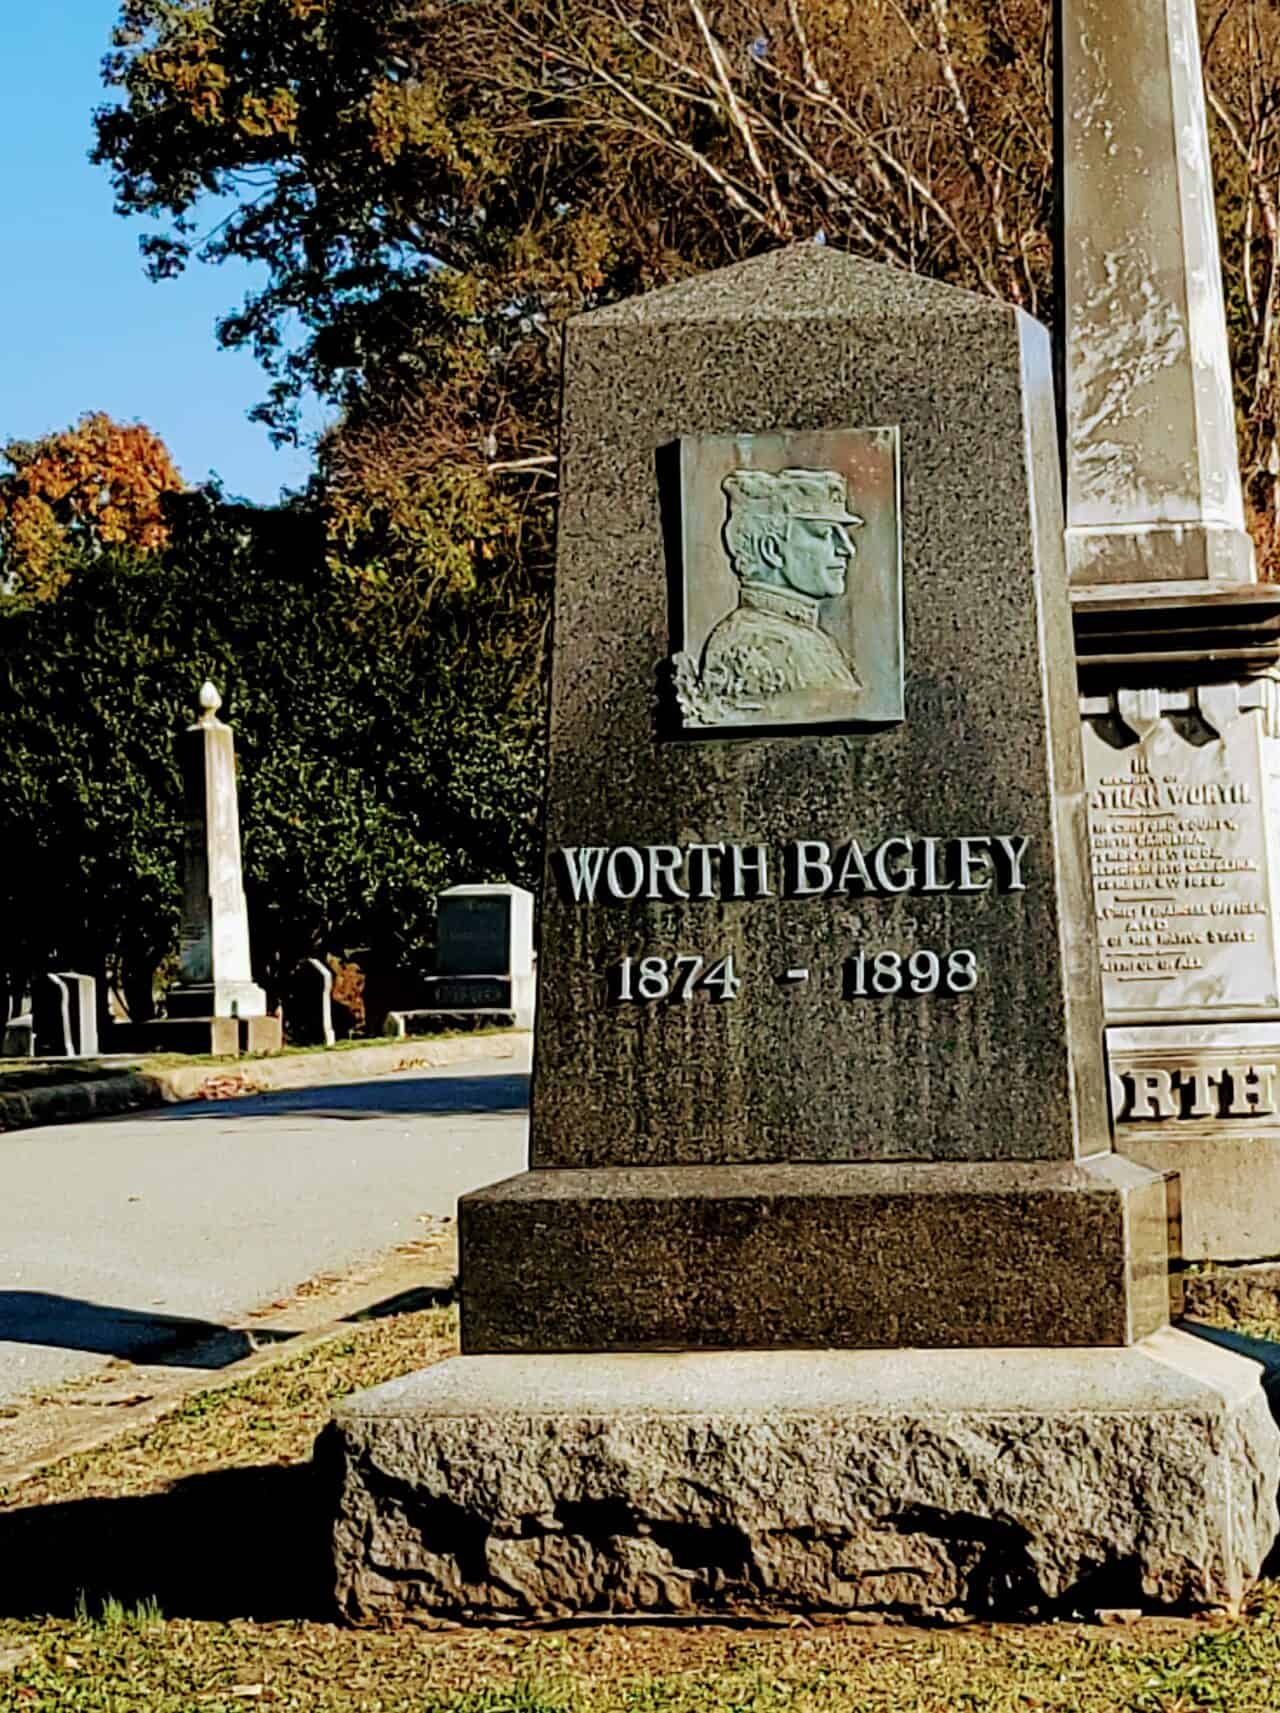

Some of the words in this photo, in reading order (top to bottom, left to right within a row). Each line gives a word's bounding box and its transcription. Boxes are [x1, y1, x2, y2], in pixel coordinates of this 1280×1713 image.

[562, 842, 772, 903] WORTH
[795, 834, 1030, 897] BAGLEY
[617, 954, 740, 1000] 1874
[850, 949, 978, 996] 1898
